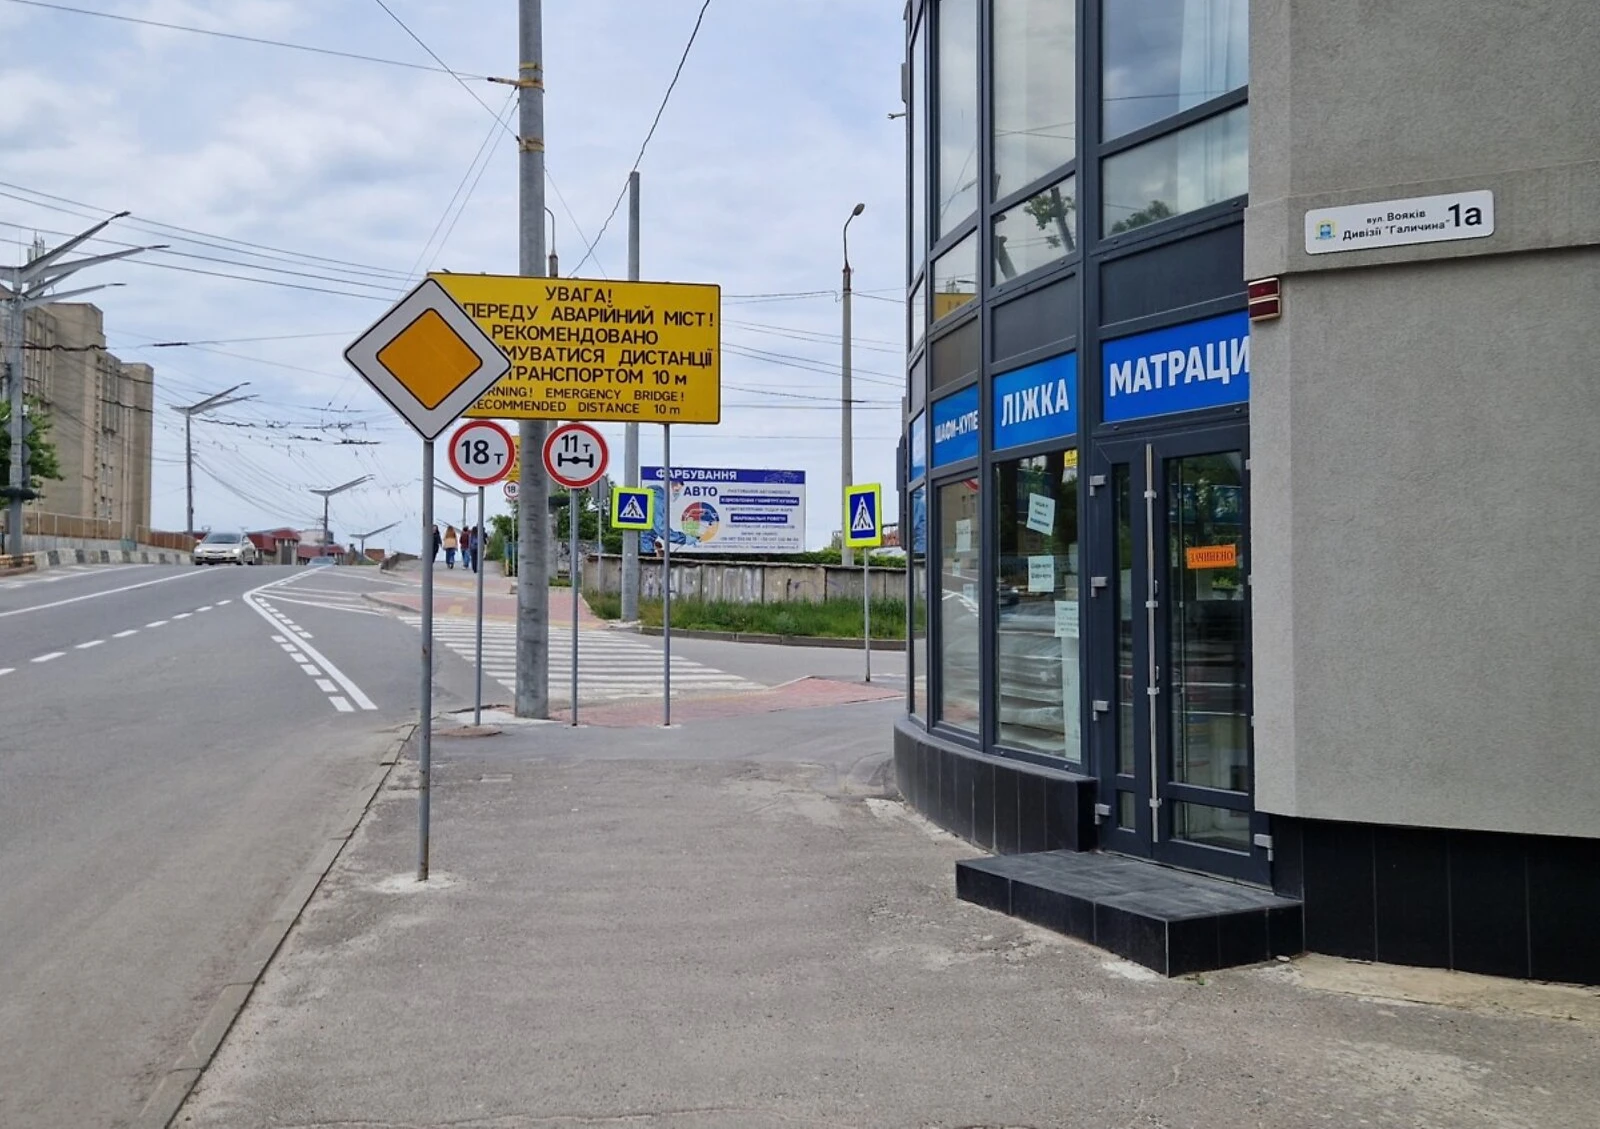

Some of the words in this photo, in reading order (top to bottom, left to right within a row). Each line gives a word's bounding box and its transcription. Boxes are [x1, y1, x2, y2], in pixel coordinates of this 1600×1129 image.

[1386, 209, 1427, 222] Вояків
[1447, 203, 1482, 227] 1а
[1342, 228, 1382, 241] Дивізії
[1385, 219, 1450, 235] "Галичина"
[545, 286, 612, 304] УВАГА!
[551, 304, 654, 325] АВАРІЙНИЙ
[664, 310, 714, 327] МІСТ!
[492, 324, 659, 346] РЕКОМЕНДОВАНО
[499, 344, 605, 363] МУВАТИСЯ
[618, 348, 713, 369] ДИСТАНЦІЇ
[1109, 335, 1250, 397] МАТРАЦИ
[652, 370, 669, 385] 10
[675, 374, 687, 385] м
[545, 387, 621, 400] EMERGENCY
[634, 390, 685, 402] BRIDGE!
[1001, 378, 1069, 428] ЛІЖКА
[578, 402, 640, 414] DISTANCE
[654, 404, 667, 414] 10
[669, 406, 680, 415] m
[934, 409, 979, 444] ШАФИ-КУПЕ
[461, 440, 490, 465] 18
[561, 434, 578, 452] 11
[507, 484, 516, 494] 18
[683, 486, 718, 497] АВТО
